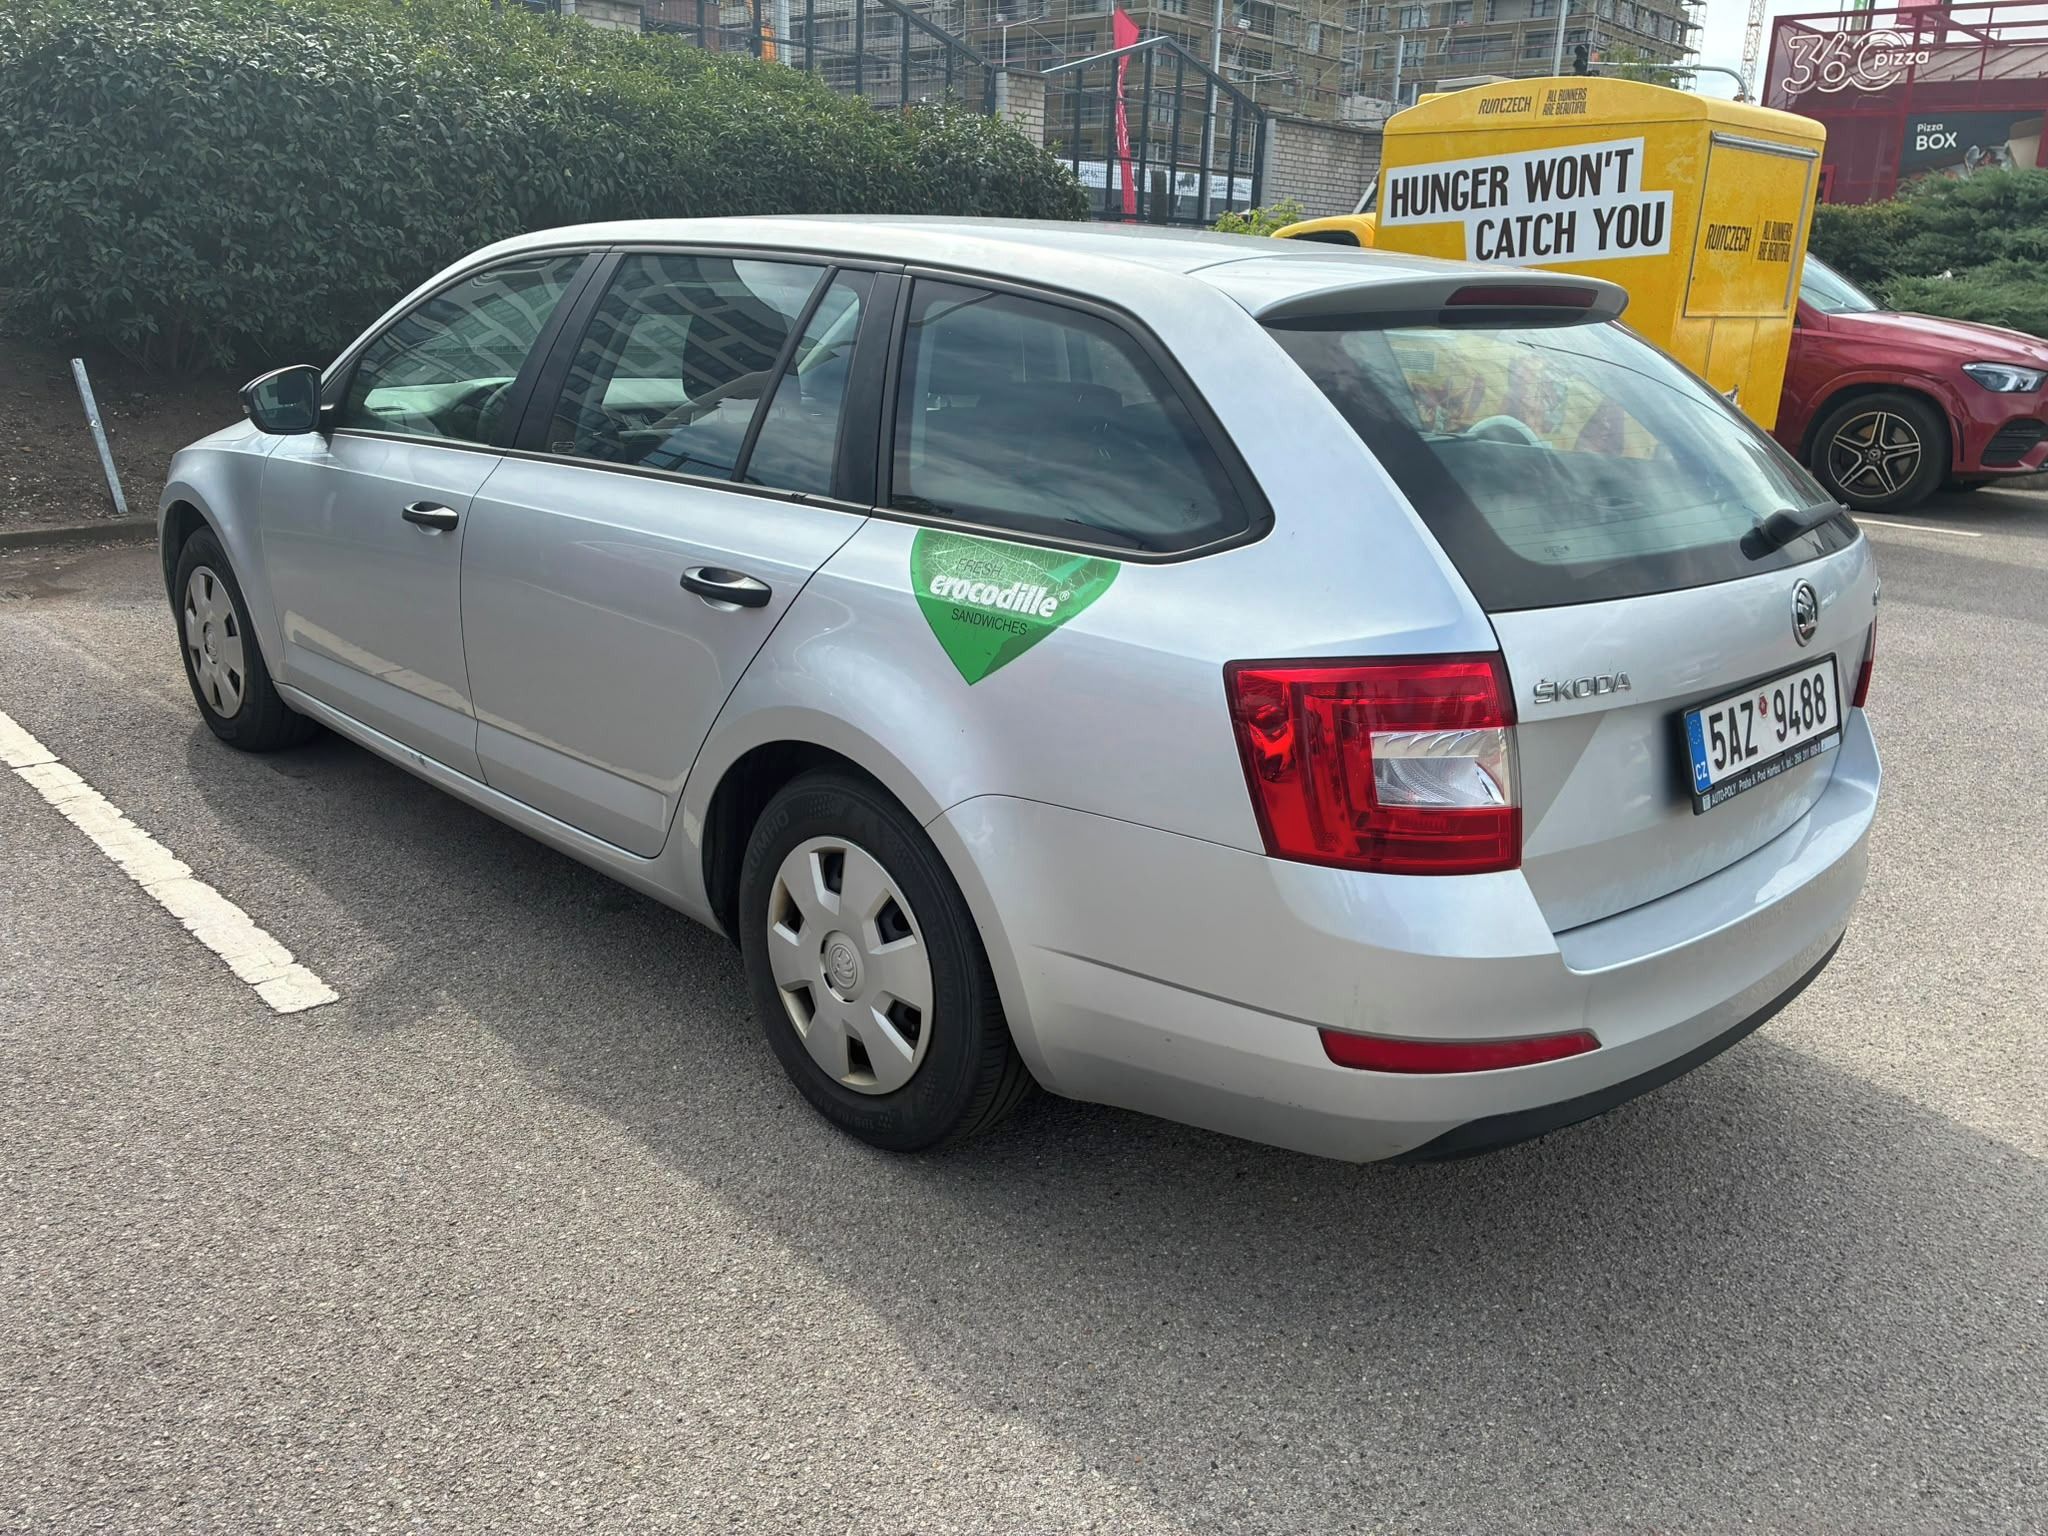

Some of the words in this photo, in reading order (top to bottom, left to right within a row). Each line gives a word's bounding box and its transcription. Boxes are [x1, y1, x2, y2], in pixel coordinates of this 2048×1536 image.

[1872, 50, 1930, 70] pizza
[1917, 122, 1944, 133] Pizza
[1915, 132, 1958, 151] BOX
[1390, 165, 1509, 219] HUNGER
[1524, 148, 1634, 203] WON'T
[1475, 210, 1577, 261] CATCH
[1593, 200, 1666, 251] YOU
[956, 558, 1002, 577] FRESH
[951, 608, 1029, 636] SANDWICHES
[1708, 699, 1759, 771] 5AZ
[1773, 673, 1827, 743] 9488
[1696, 761, 1708, 781] CZ
